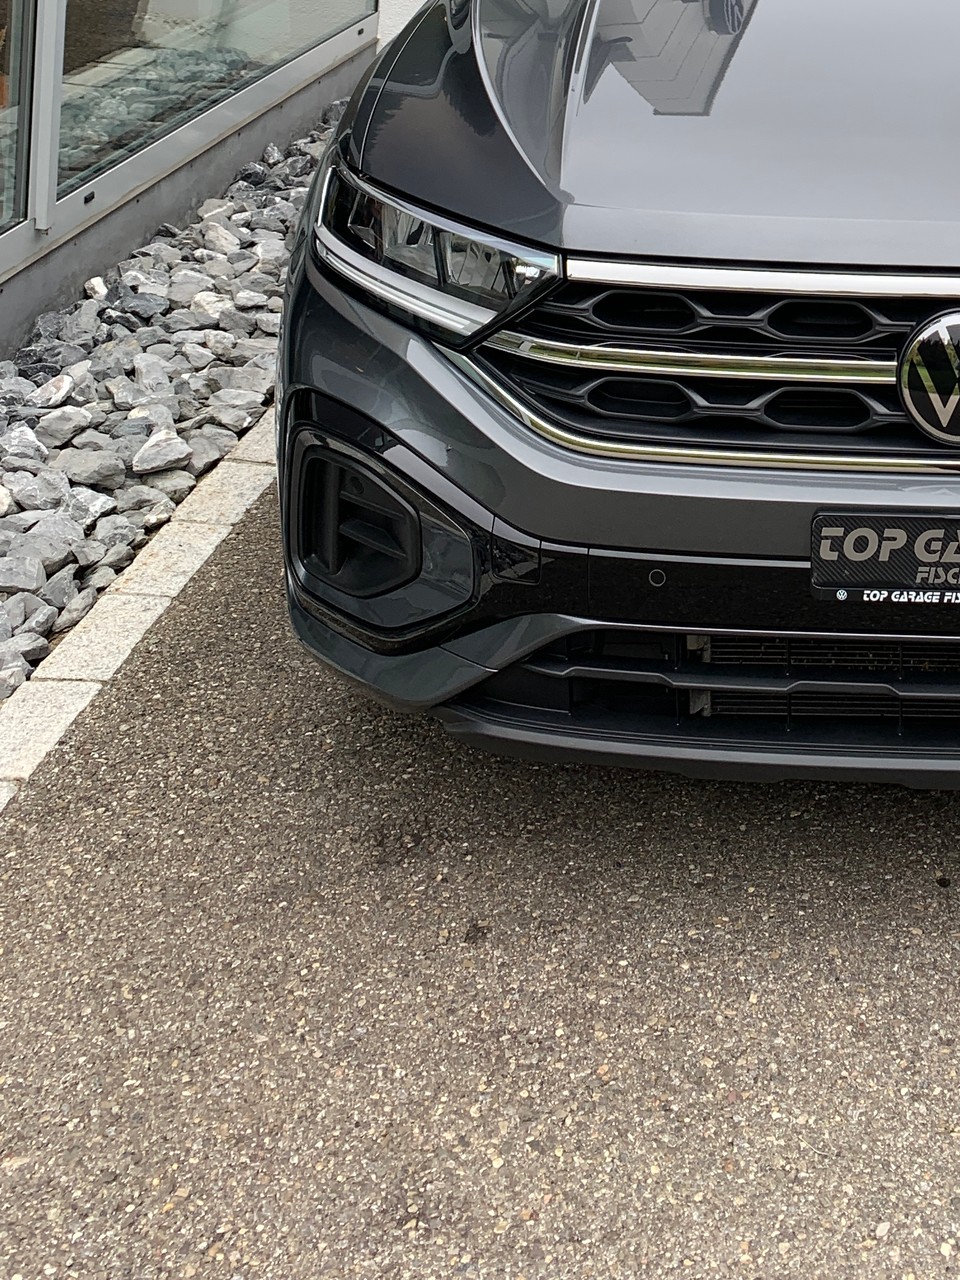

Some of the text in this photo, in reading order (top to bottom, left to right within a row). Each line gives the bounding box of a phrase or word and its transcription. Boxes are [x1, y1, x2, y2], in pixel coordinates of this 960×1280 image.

[819, 527, 908, 562] TOP
[863, 590, 889, 602] TOP
[890, 591, 941, 603] GARAGE
